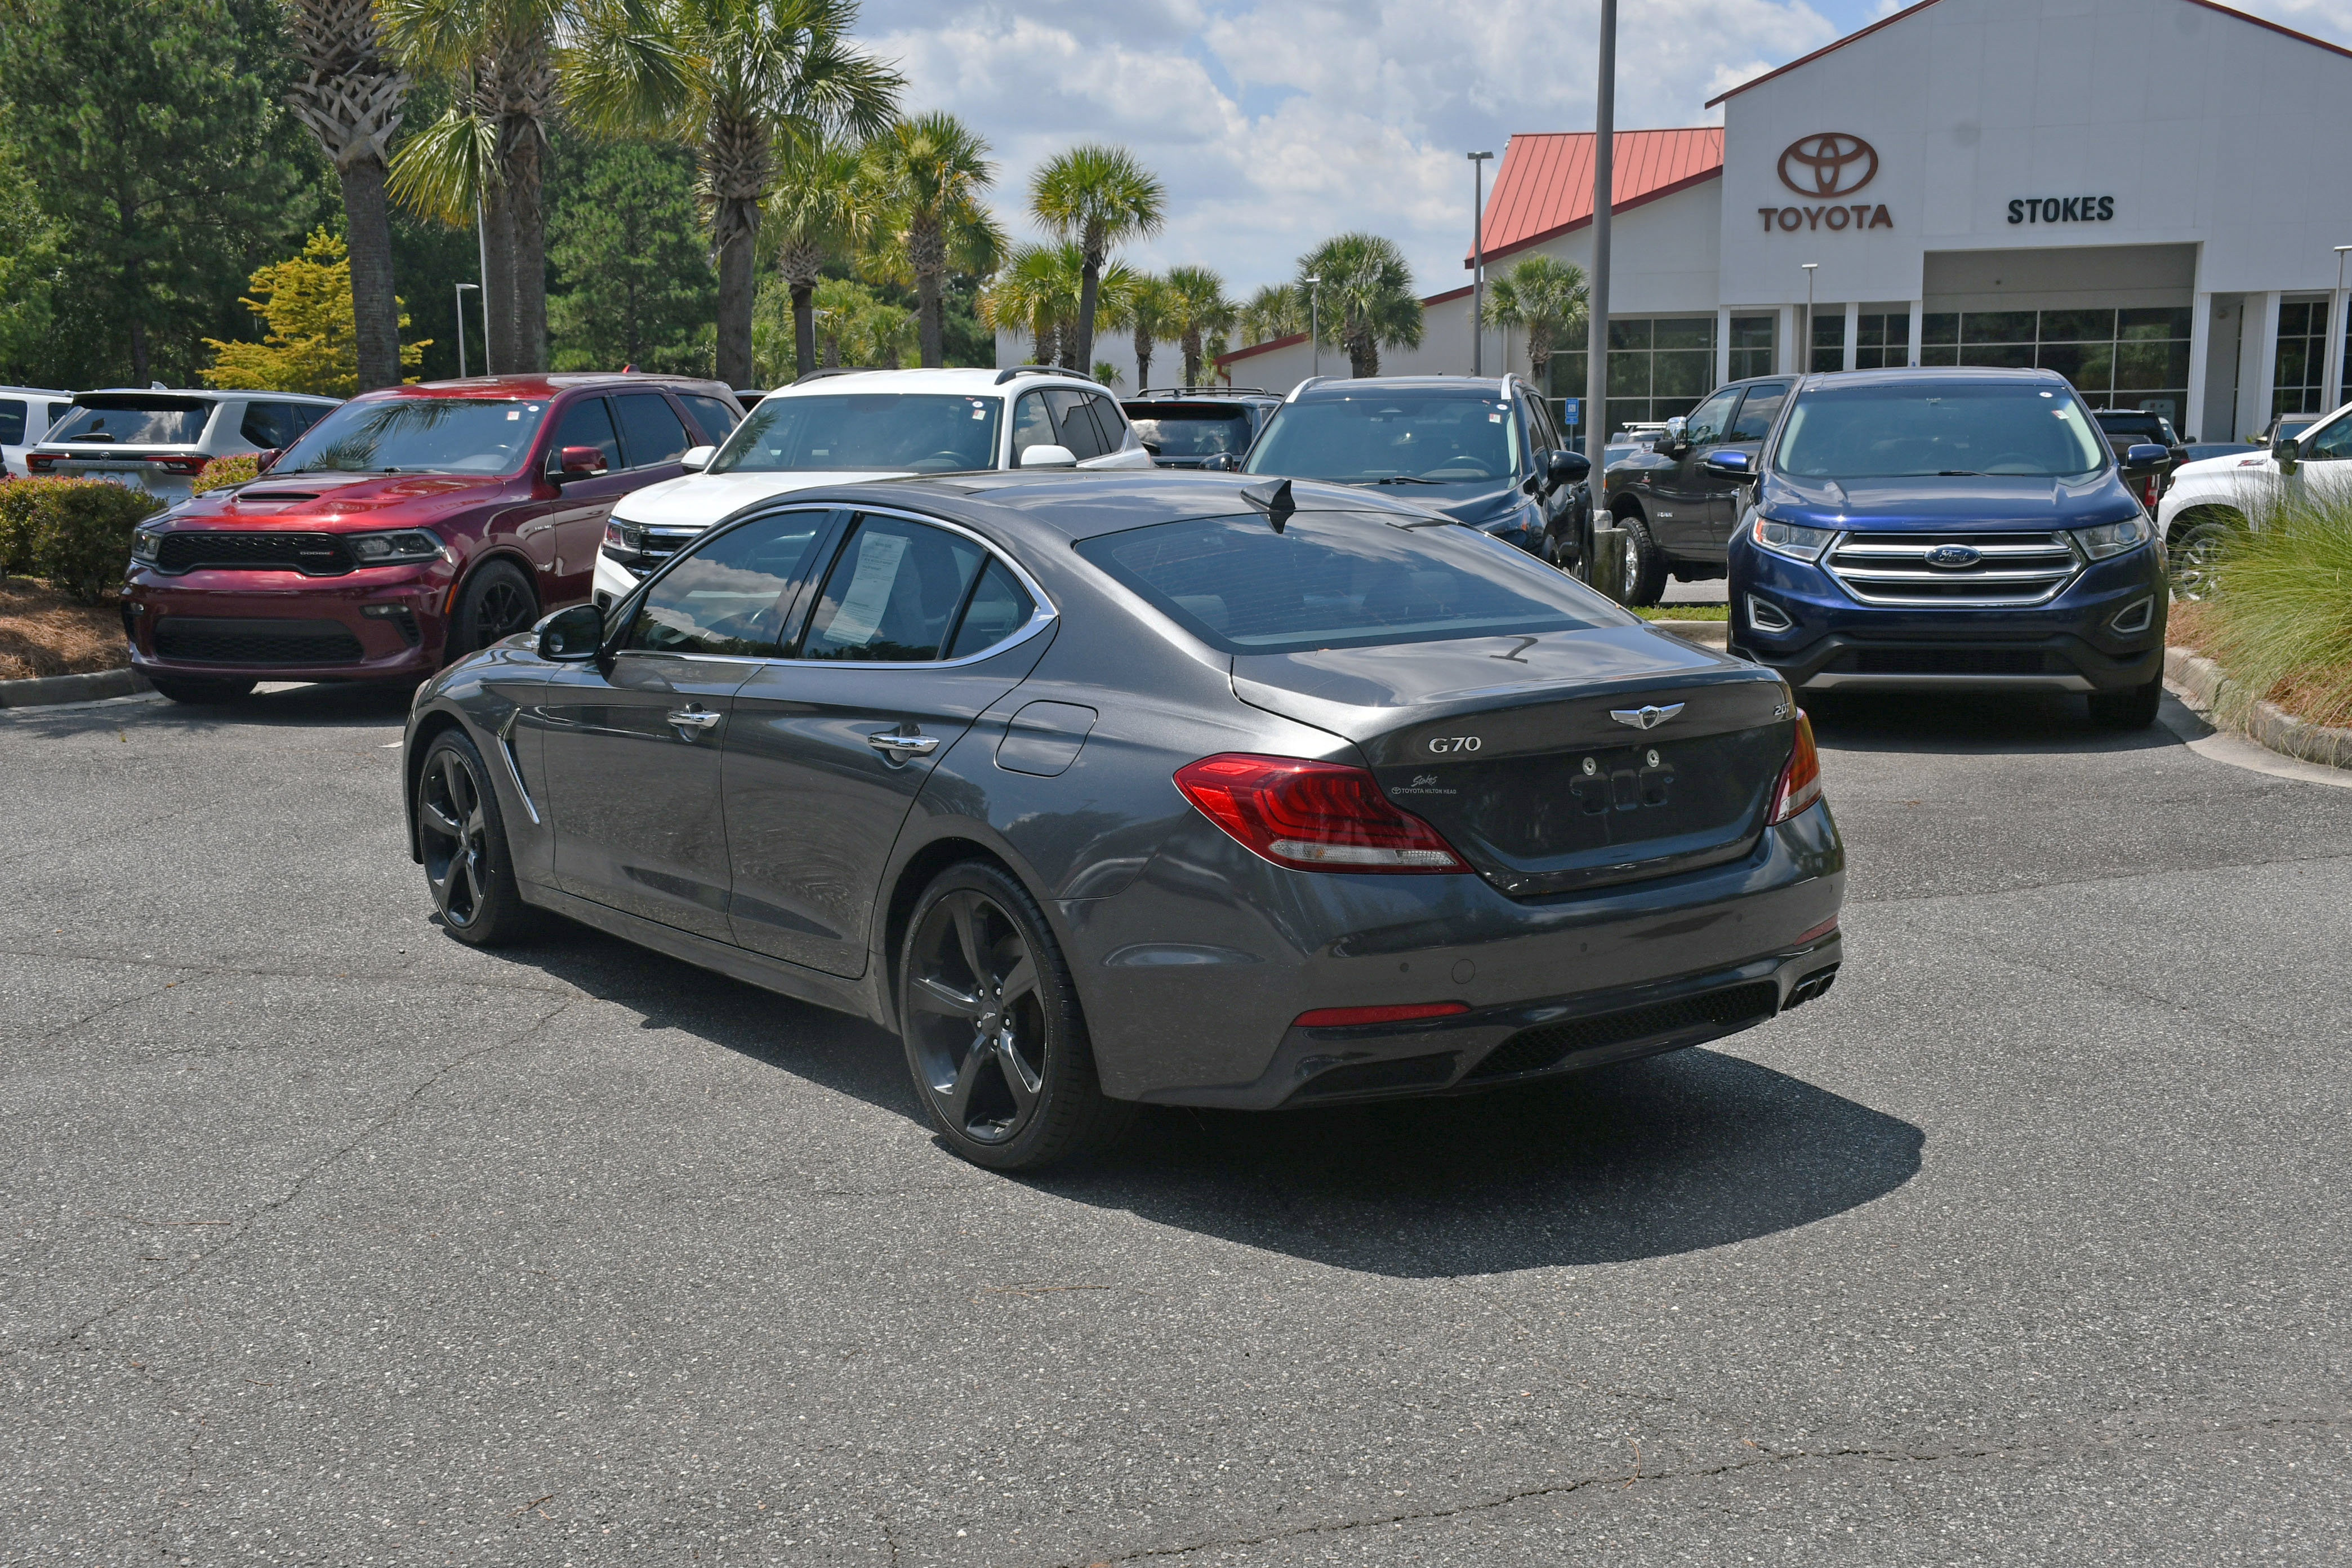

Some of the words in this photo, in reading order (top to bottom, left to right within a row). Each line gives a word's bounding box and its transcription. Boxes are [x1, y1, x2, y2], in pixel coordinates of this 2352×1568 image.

[1757, 204, 1894, 232] TOYOTA
[2007, 195, 2115, 224] STOKES
[1938, 549, 1968, 562] Ford
[1428, 736, 1482, 753] G70
[1410, 774, 1438, 787] Stokes
